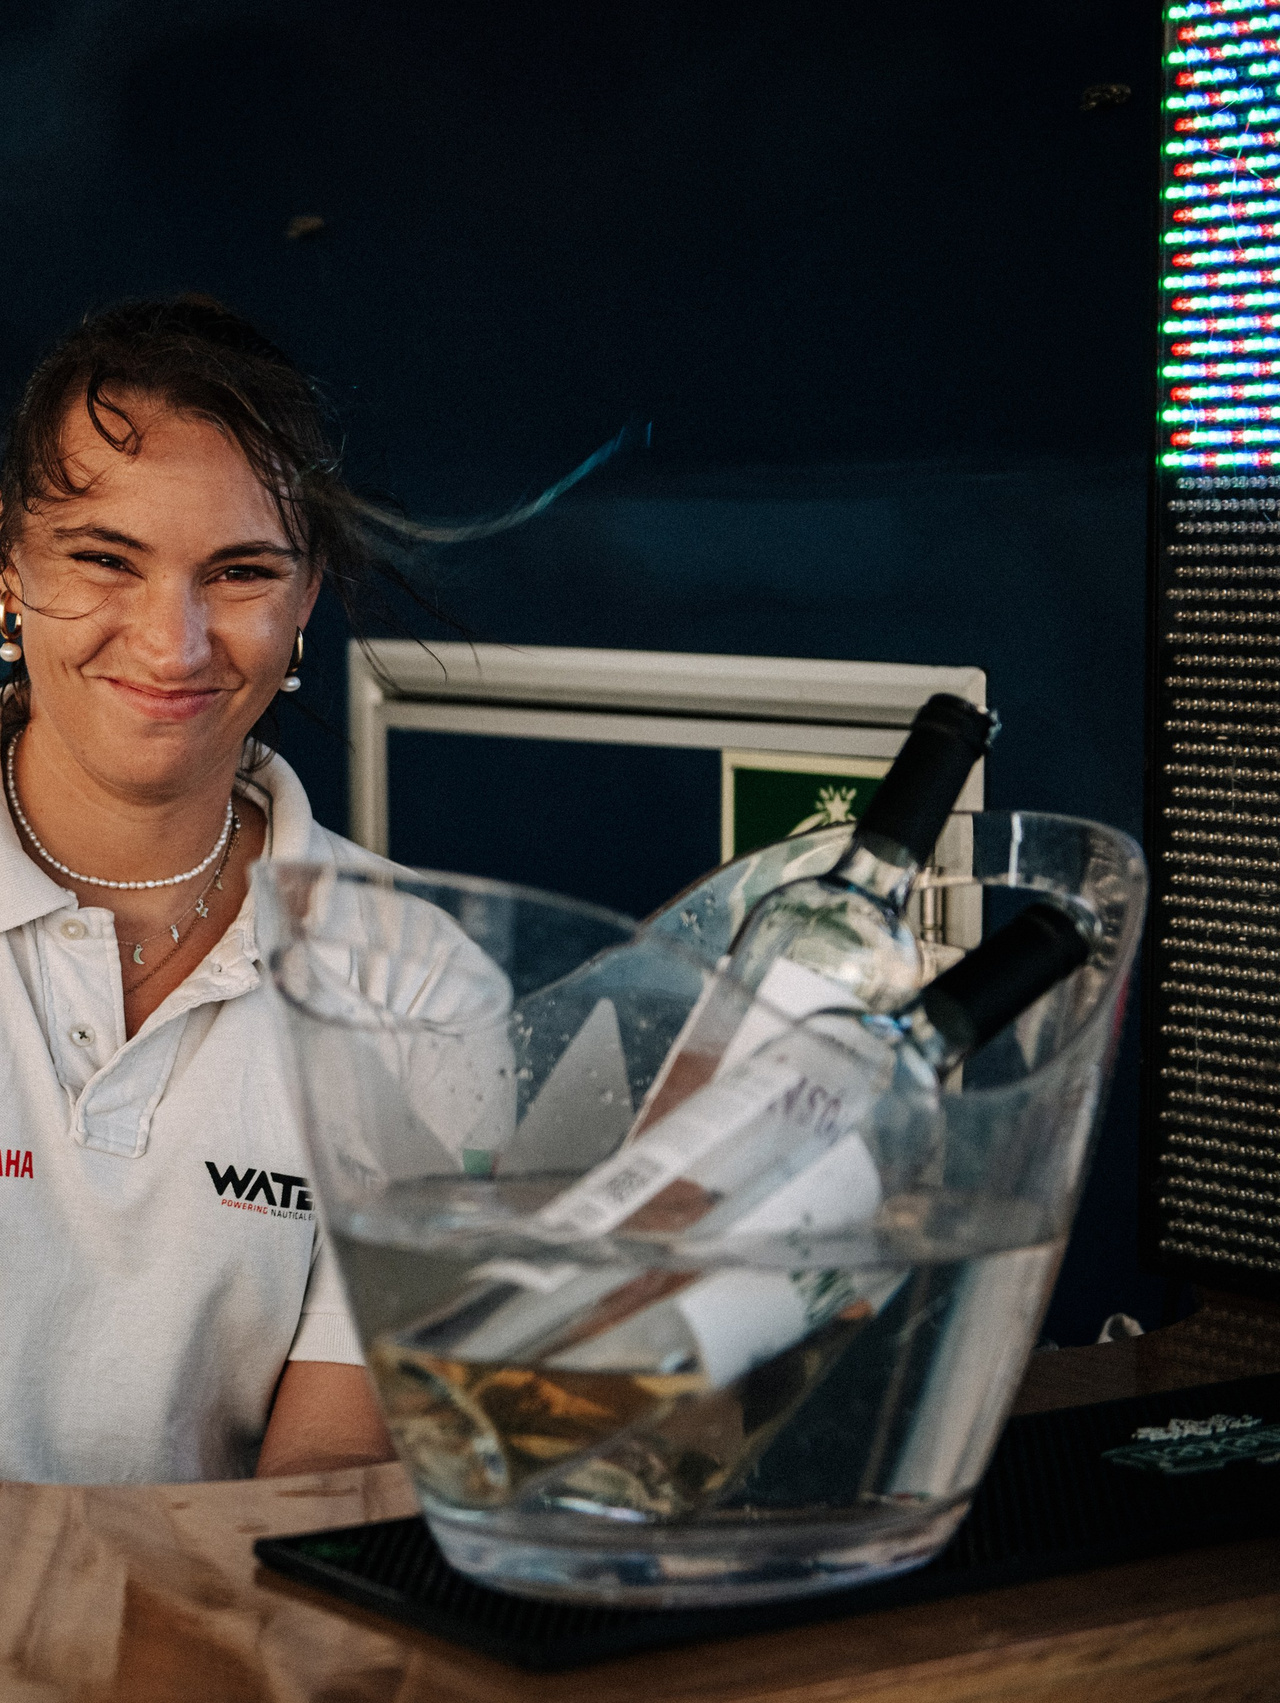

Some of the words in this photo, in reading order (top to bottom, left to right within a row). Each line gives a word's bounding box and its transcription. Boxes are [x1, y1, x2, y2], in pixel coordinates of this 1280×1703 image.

[204, 1160, 314, 1212] WATE
[221, 1198, 269, 1215] POWERING
[270, 1208, 308, 1221] NAUTICAL
